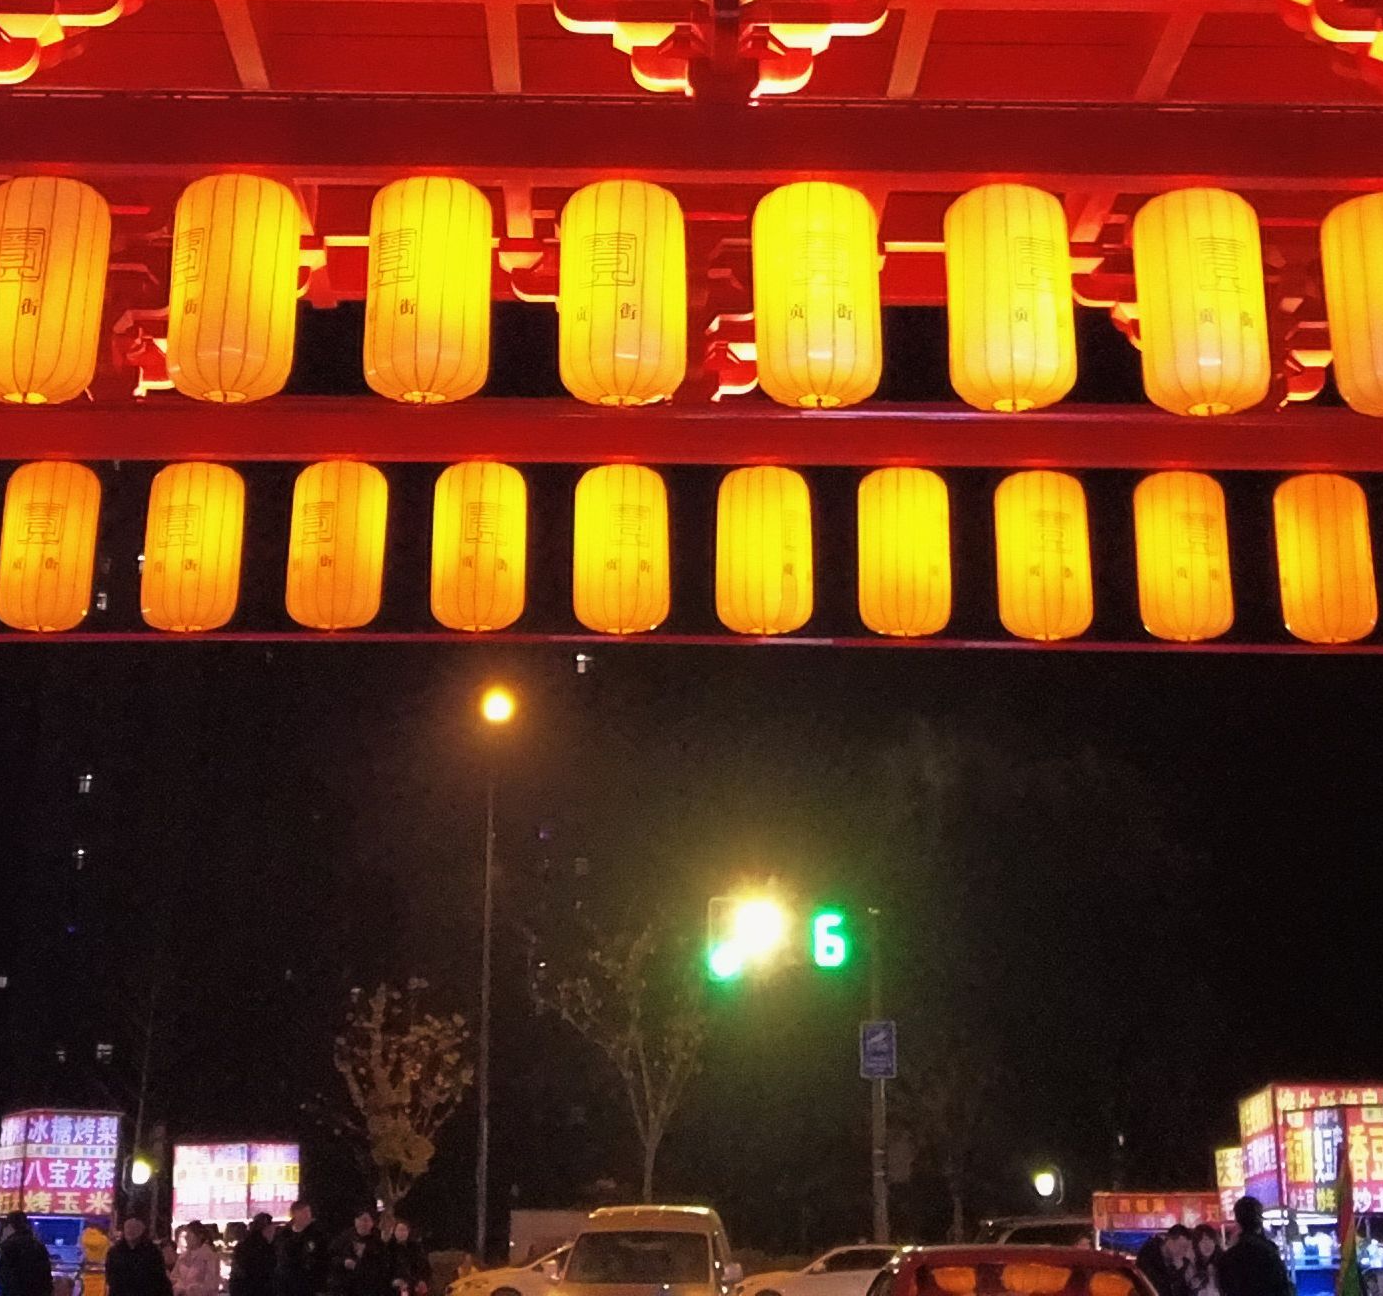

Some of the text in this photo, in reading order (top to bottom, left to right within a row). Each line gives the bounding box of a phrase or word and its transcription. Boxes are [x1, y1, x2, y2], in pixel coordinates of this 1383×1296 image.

[814, 913, 846, 967] 6
[28, 1115, 118, 1144] 冰糖烤梨
[24, 1159, 115, 1188] 八宝龙茶
[23, 1190, 113, 1215] 烤玉米
